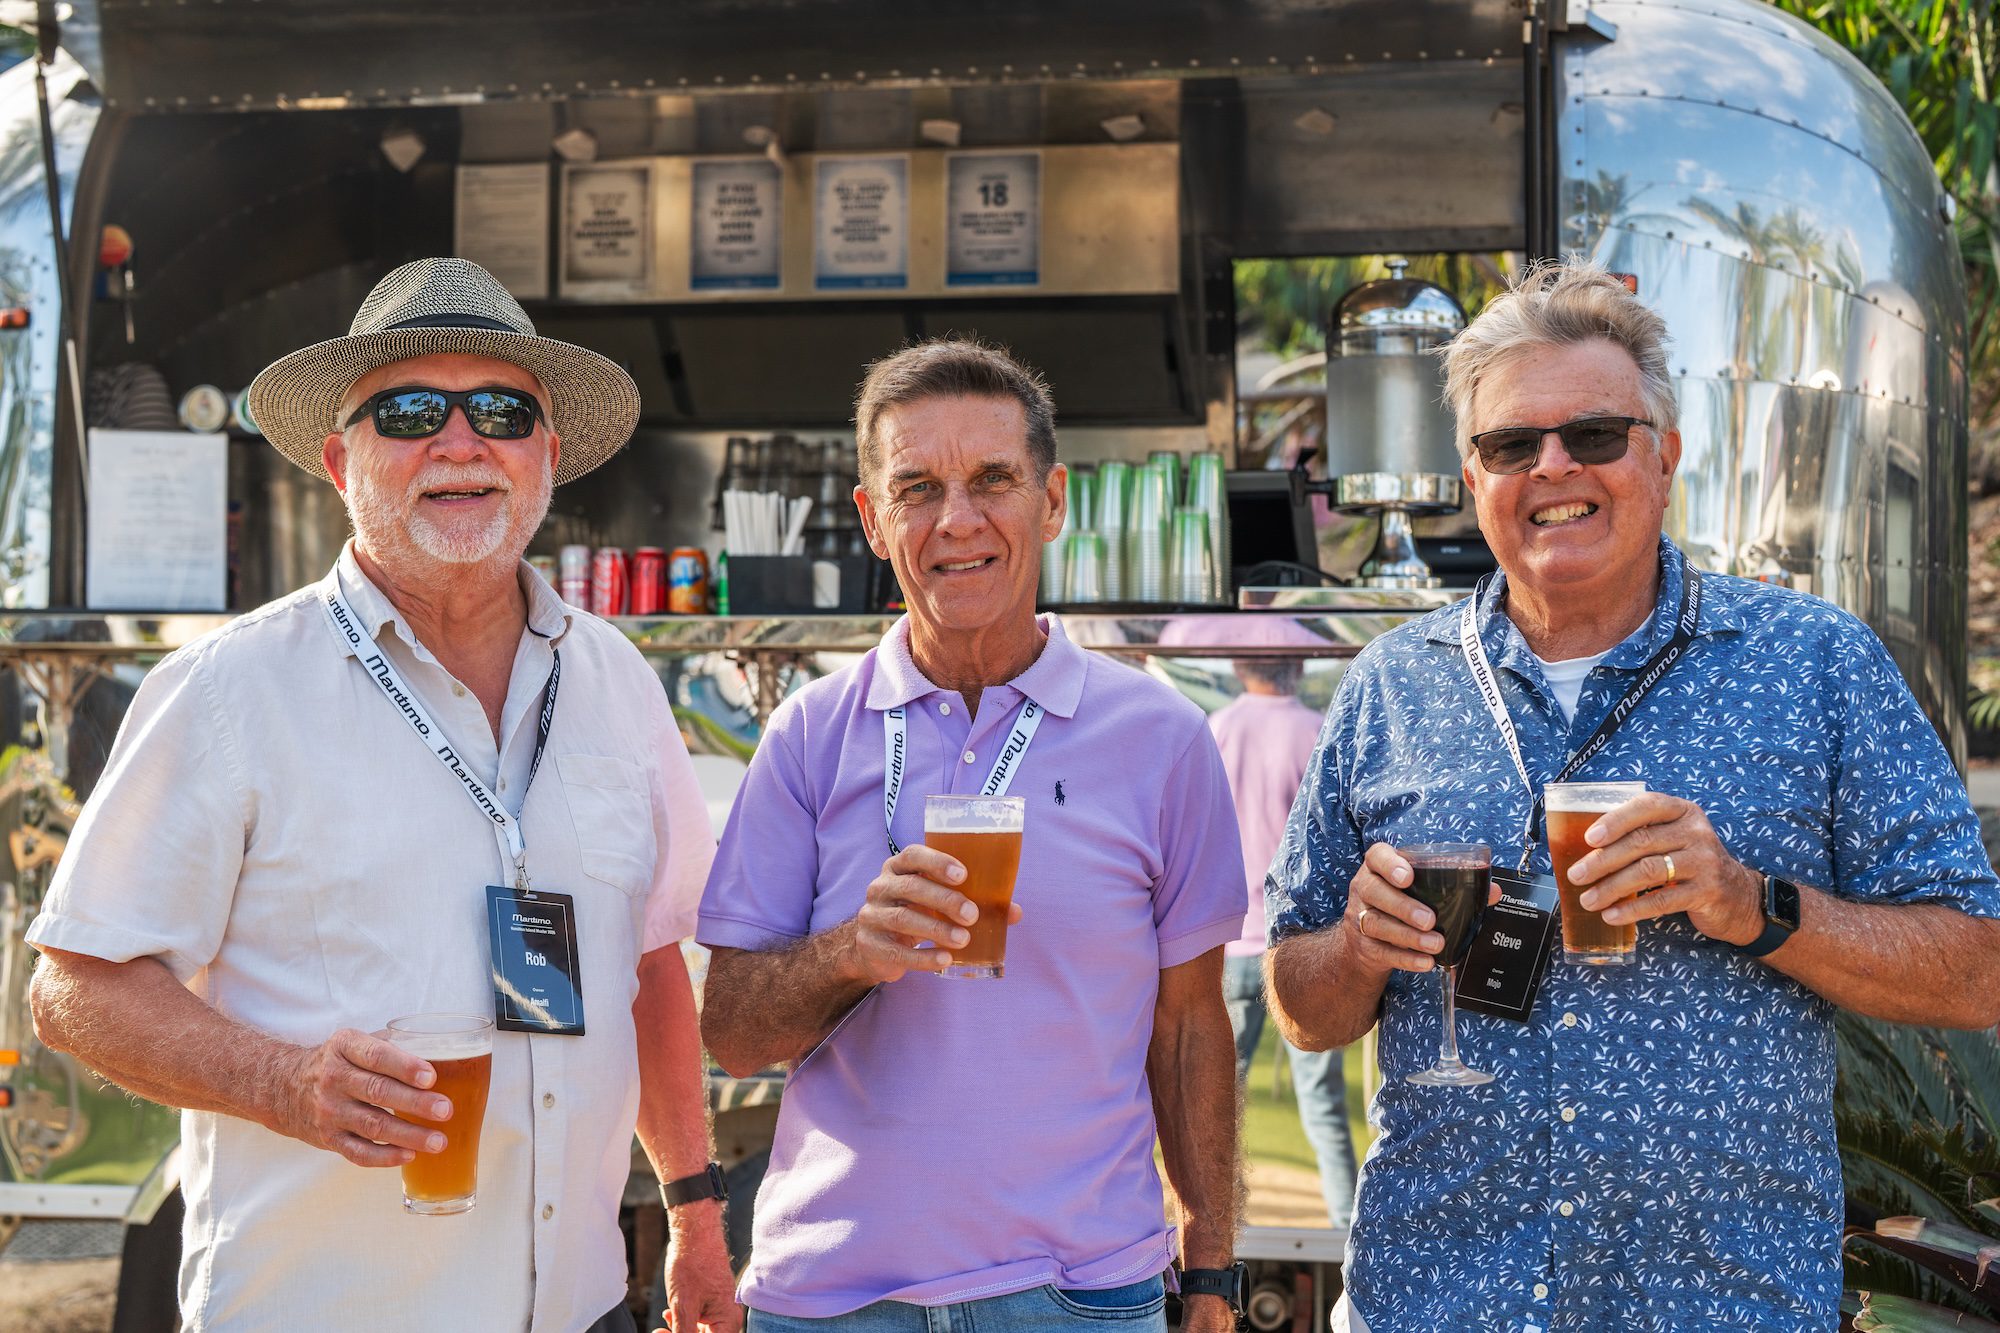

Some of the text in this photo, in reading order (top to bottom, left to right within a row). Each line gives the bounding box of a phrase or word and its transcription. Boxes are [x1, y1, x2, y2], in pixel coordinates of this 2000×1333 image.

[977, 182, 1009, 208] 18
[1492, 932, 1522, 950] Steve
[525, 952, 547, 967] Rob
[1487, 978, 1501, 989] Mojo
